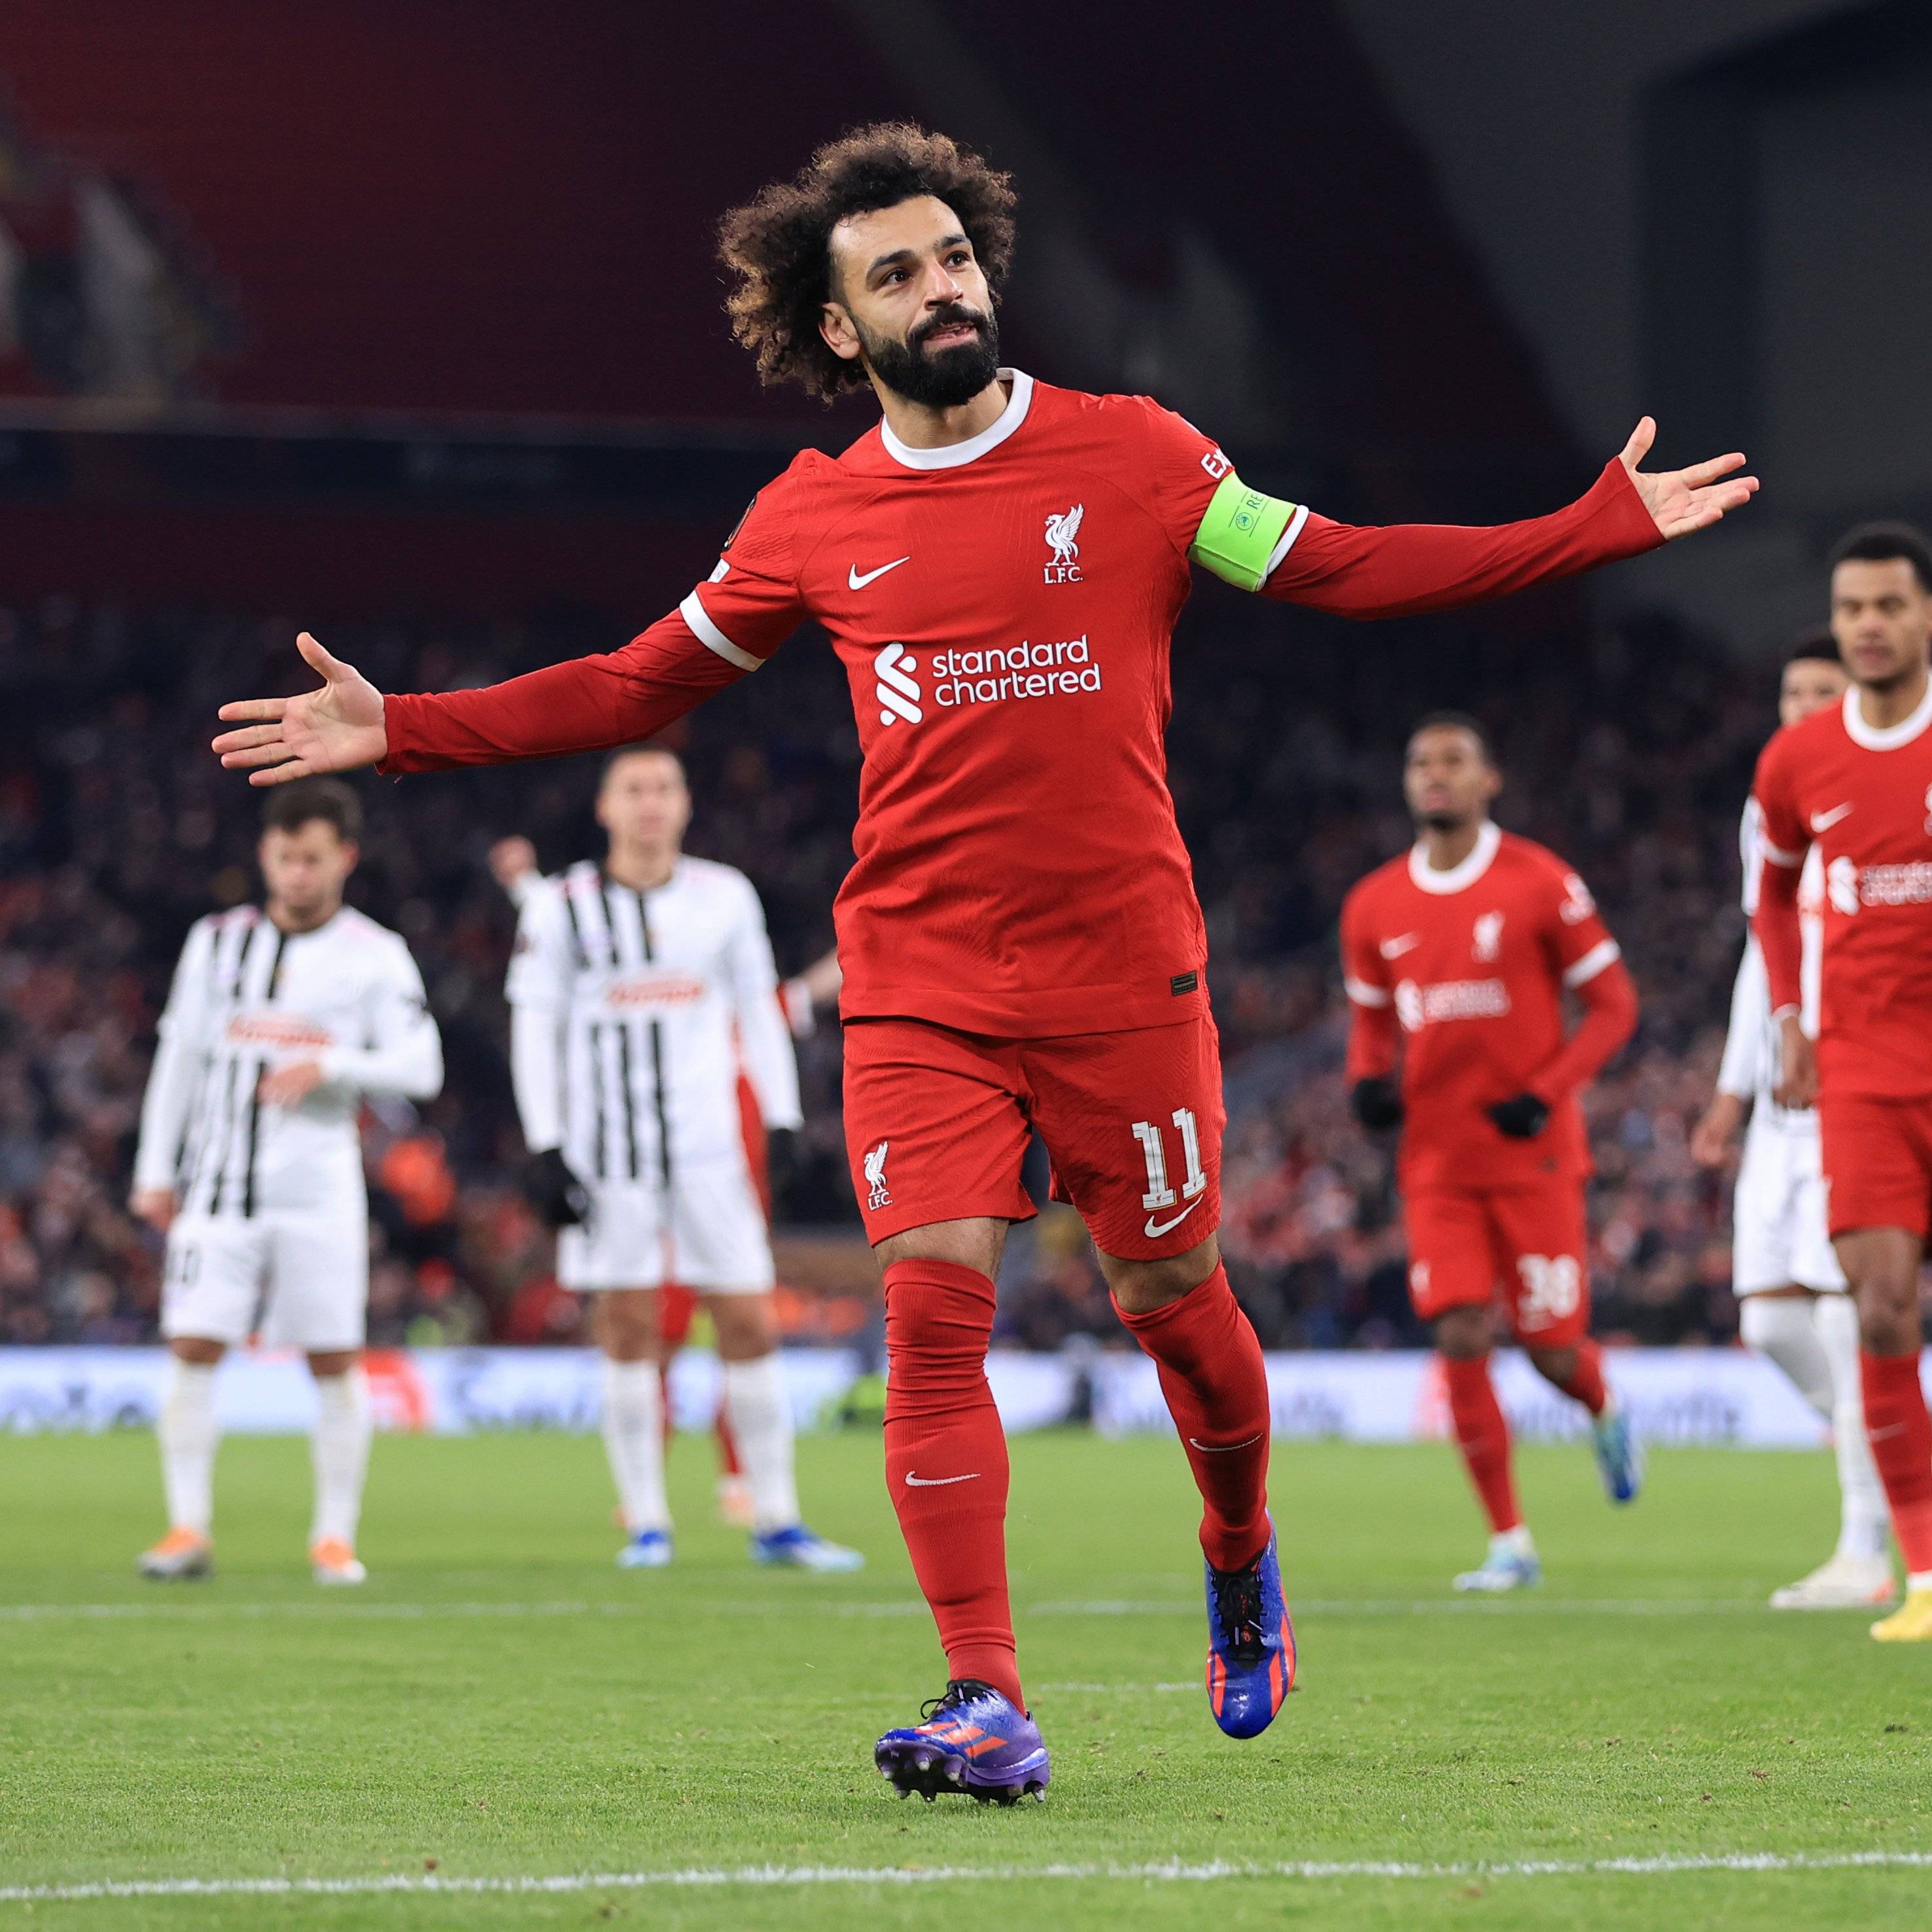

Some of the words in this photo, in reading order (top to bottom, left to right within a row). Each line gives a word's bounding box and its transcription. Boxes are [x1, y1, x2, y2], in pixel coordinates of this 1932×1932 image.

[1201, 447, 1233, 480] Ex
[1246, 493, 1265, 510] RE
[1044, 566, 1083, 584] L.F.C.
[932, 633, 1089, 678] standard
[934, 662, 1101, 707] chartered
[1131, 1107, 1208, 1212] 11
[868, 1191, 893, 1211] L.F.C.
